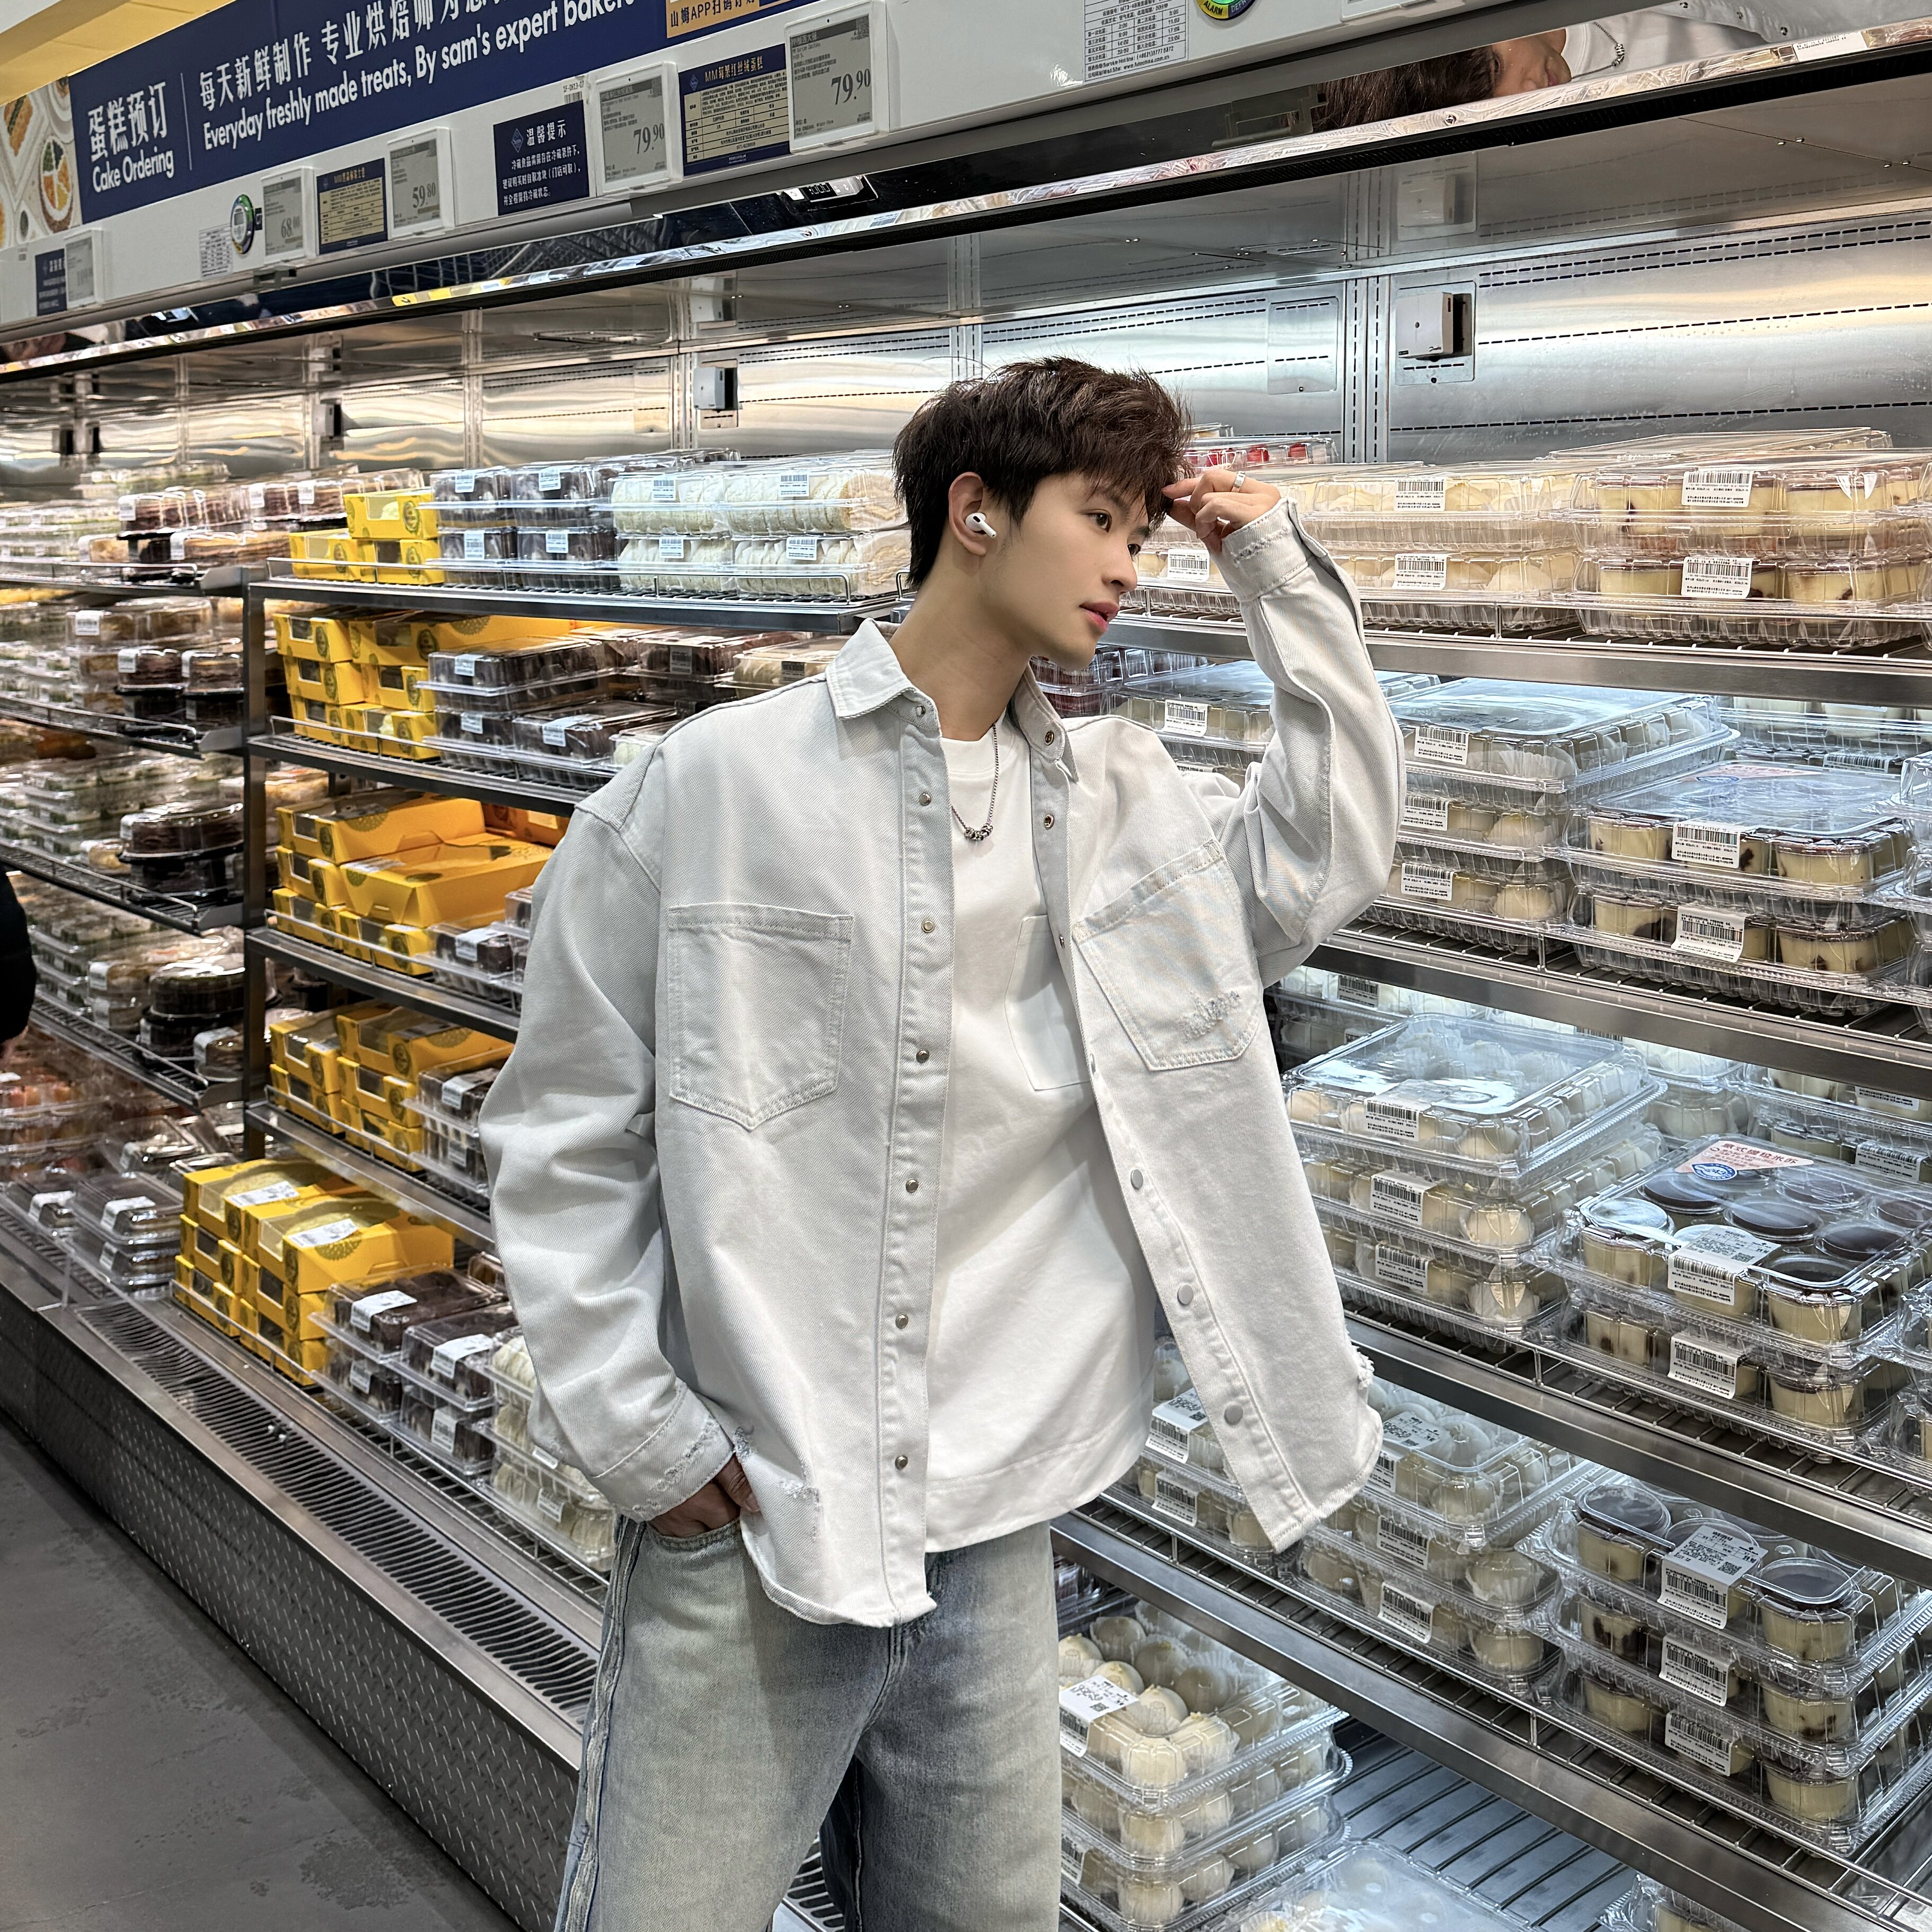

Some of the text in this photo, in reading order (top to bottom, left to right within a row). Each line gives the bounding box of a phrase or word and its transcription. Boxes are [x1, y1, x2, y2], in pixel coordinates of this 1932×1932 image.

[671, 0, 754, 27] 山姆APP扫码
[1204, 1, 1223, 15] ALARM
[200, 0, 500, 111] 每天新鲜制作 专业烘焙师
[204, 0, 634, 150] Everyday freshly made treats, By sam's expert bake
[831, 68, 871, 105] 79.90
[88, 82, 167, 162] 蛋糕预订
[526, 119, 567, 146] 温馨提示
[633, 122, 665, 154] 79.90
[93, 146, 174, 192] Cake Ordering
[412, 182, 436, 208] 59.80
